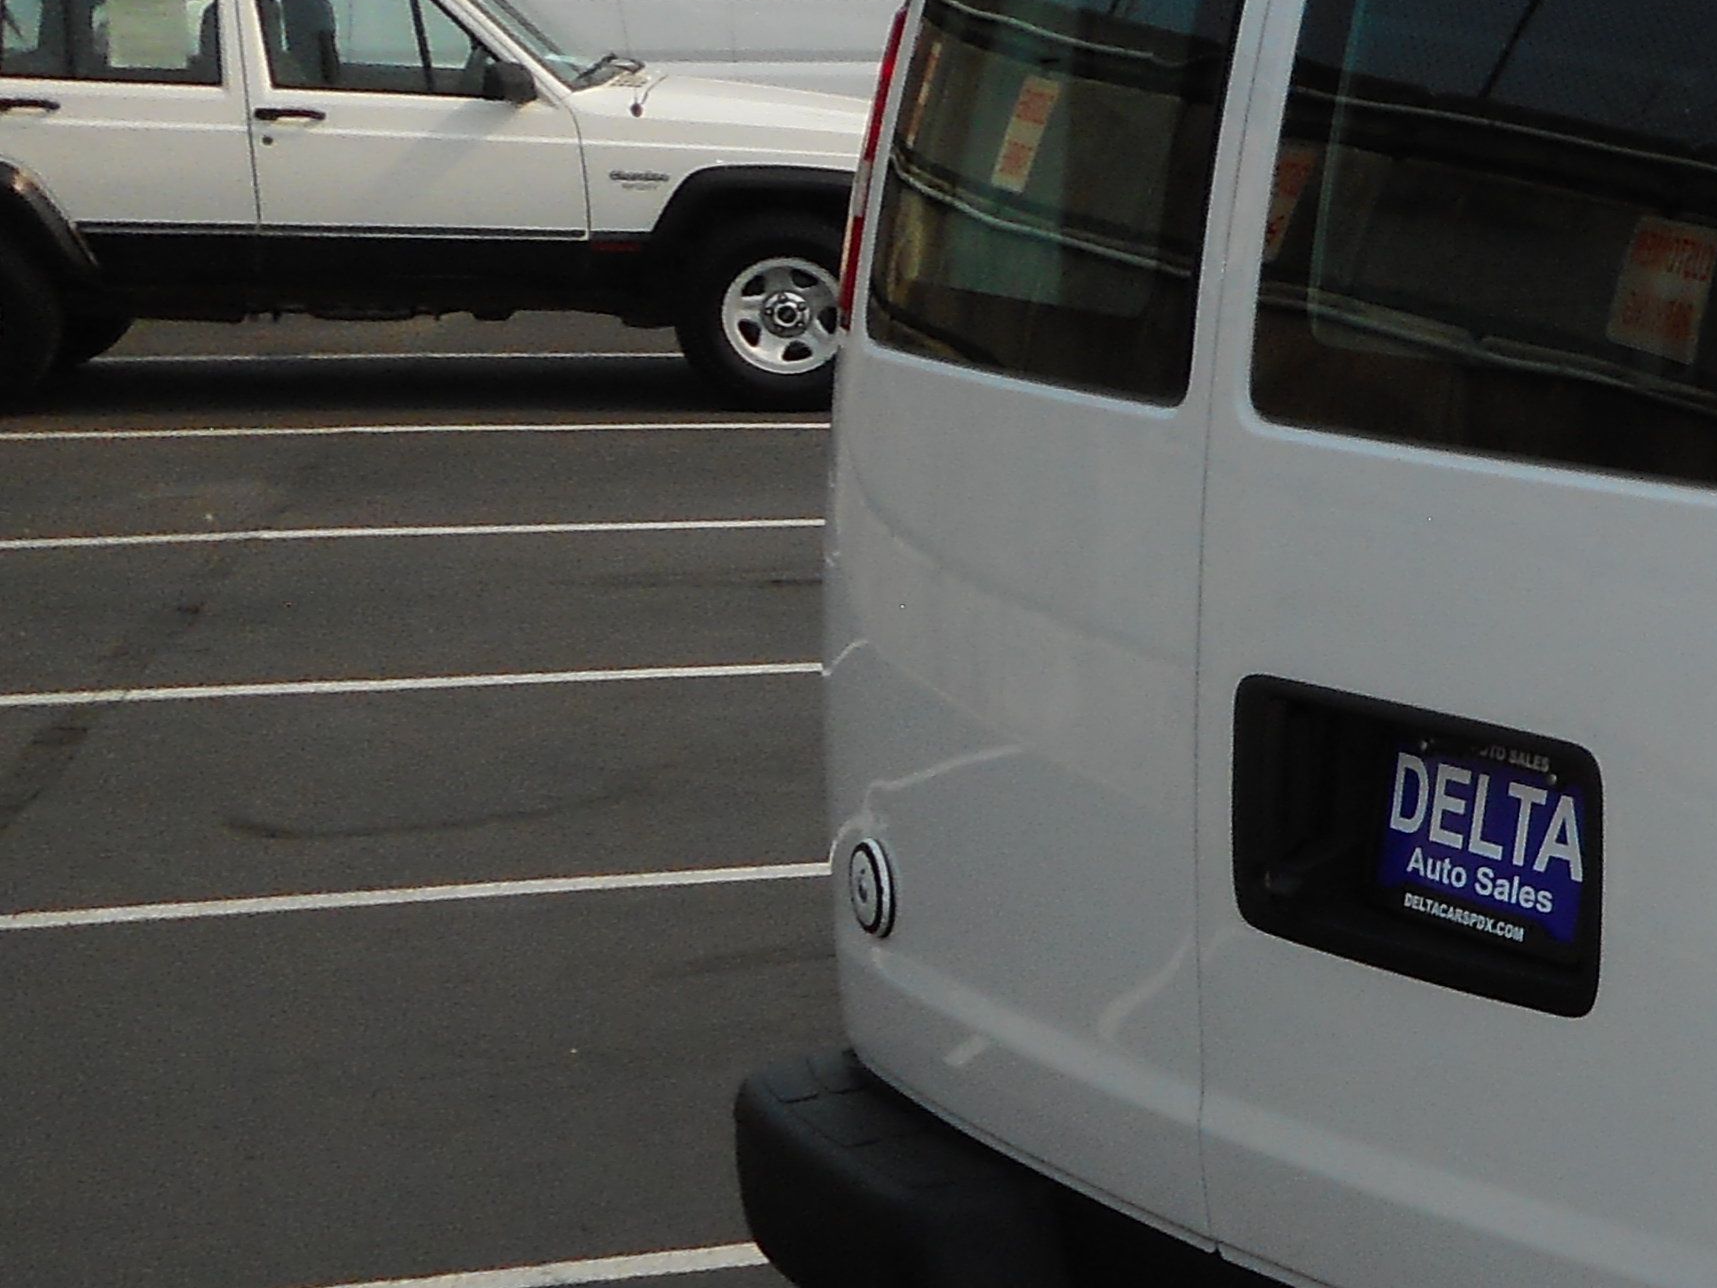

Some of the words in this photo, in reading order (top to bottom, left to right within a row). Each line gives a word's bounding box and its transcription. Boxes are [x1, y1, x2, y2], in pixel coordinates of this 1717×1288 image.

[1510, 749, 1554, 774] SALES
[1389, 751, 1584, 883] DELTA
[1406, 846, 1468, 889] Auto
[1474, 866, 1554, 914] Sales
[1403, 892, 1525, 943] DELTACARSPDX.COM
